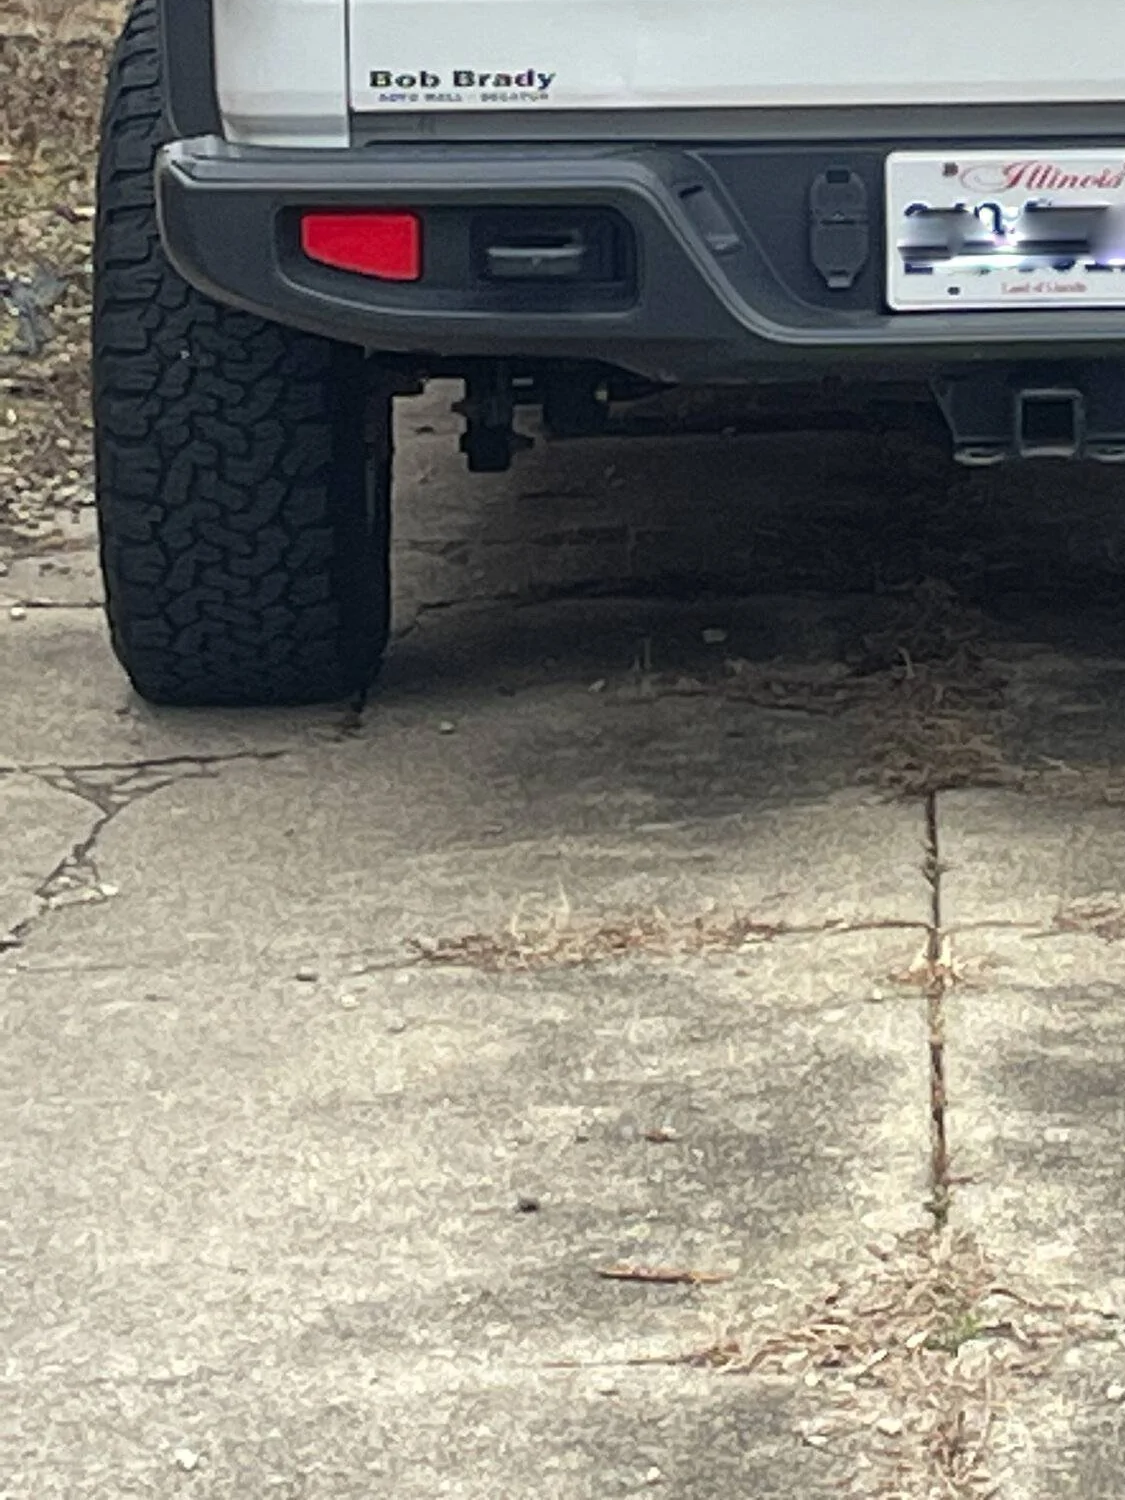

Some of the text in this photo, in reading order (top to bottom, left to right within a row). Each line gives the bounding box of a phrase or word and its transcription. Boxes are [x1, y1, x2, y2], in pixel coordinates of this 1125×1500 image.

[369, 68, 556, 90] Bob Brady
[960, 160, 1125, 192] Illinois
